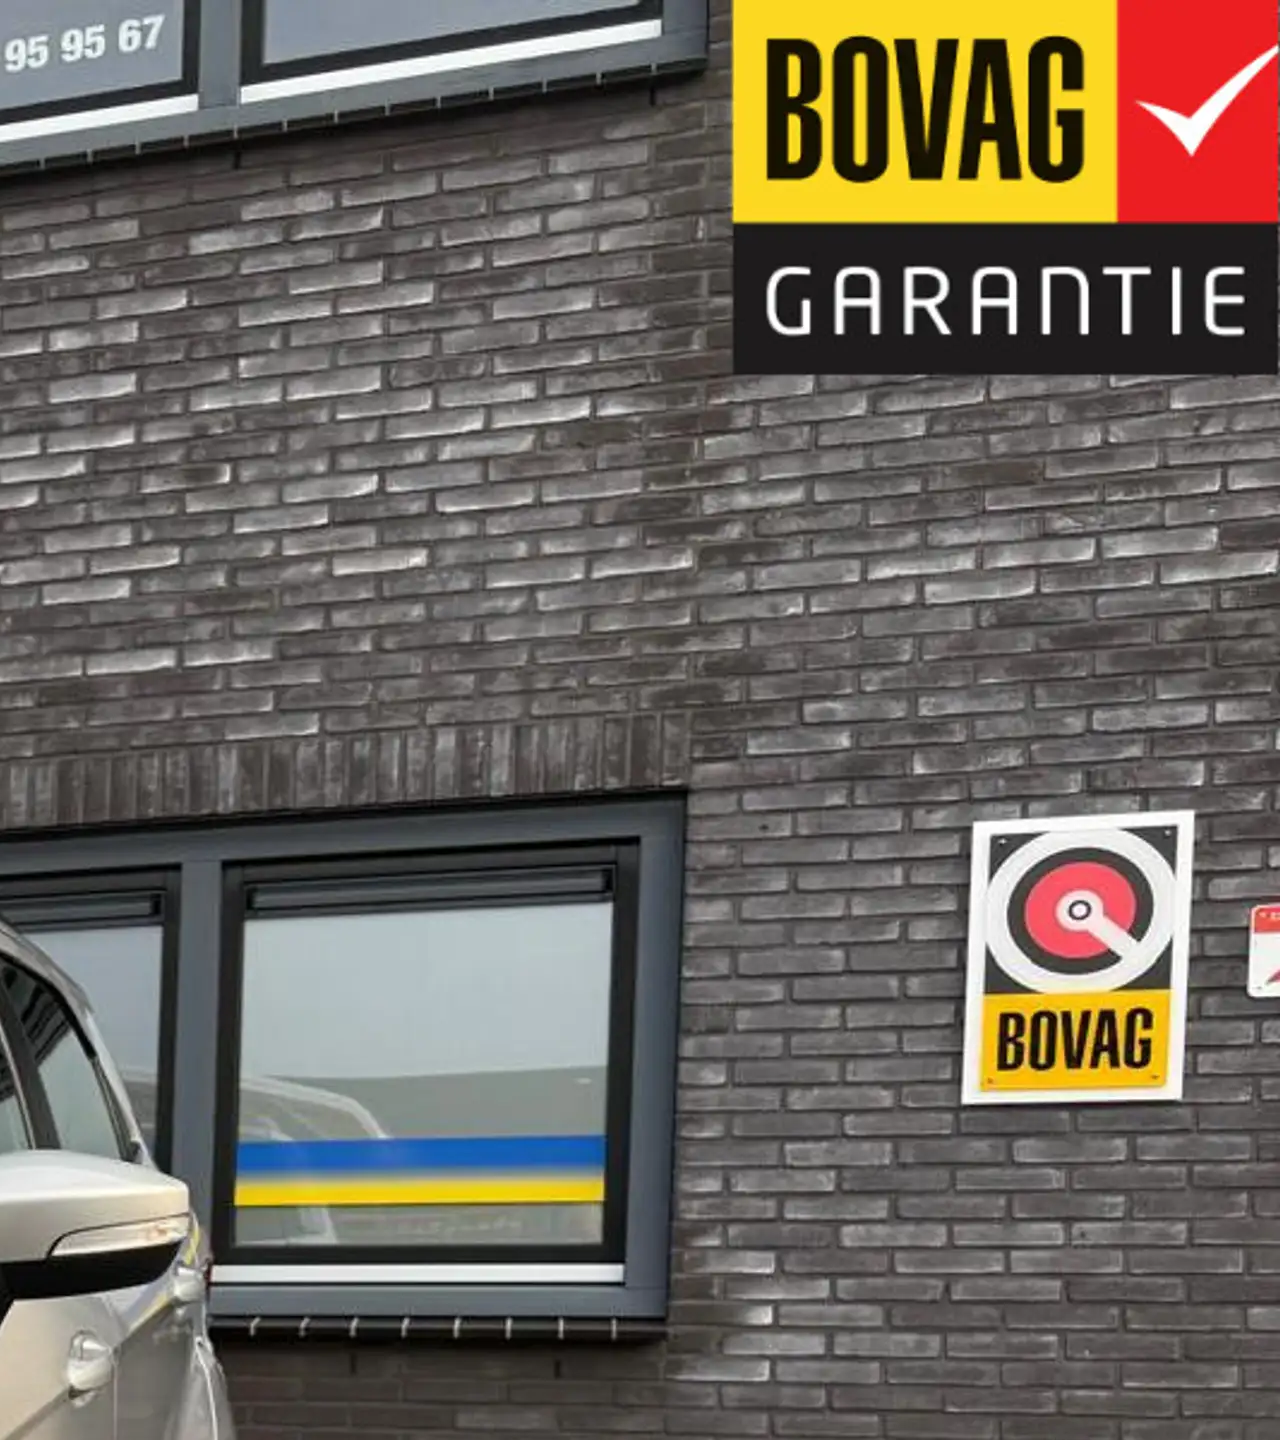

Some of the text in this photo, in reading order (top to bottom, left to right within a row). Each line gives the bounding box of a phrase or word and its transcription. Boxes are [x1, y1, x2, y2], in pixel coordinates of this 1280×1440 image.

[5, 34, 49, 73] 95
[61, 24, 106, 63] 95
[118, 14, 166, 53] 67
[997, 1008, 1153, 1072] BOVAG
